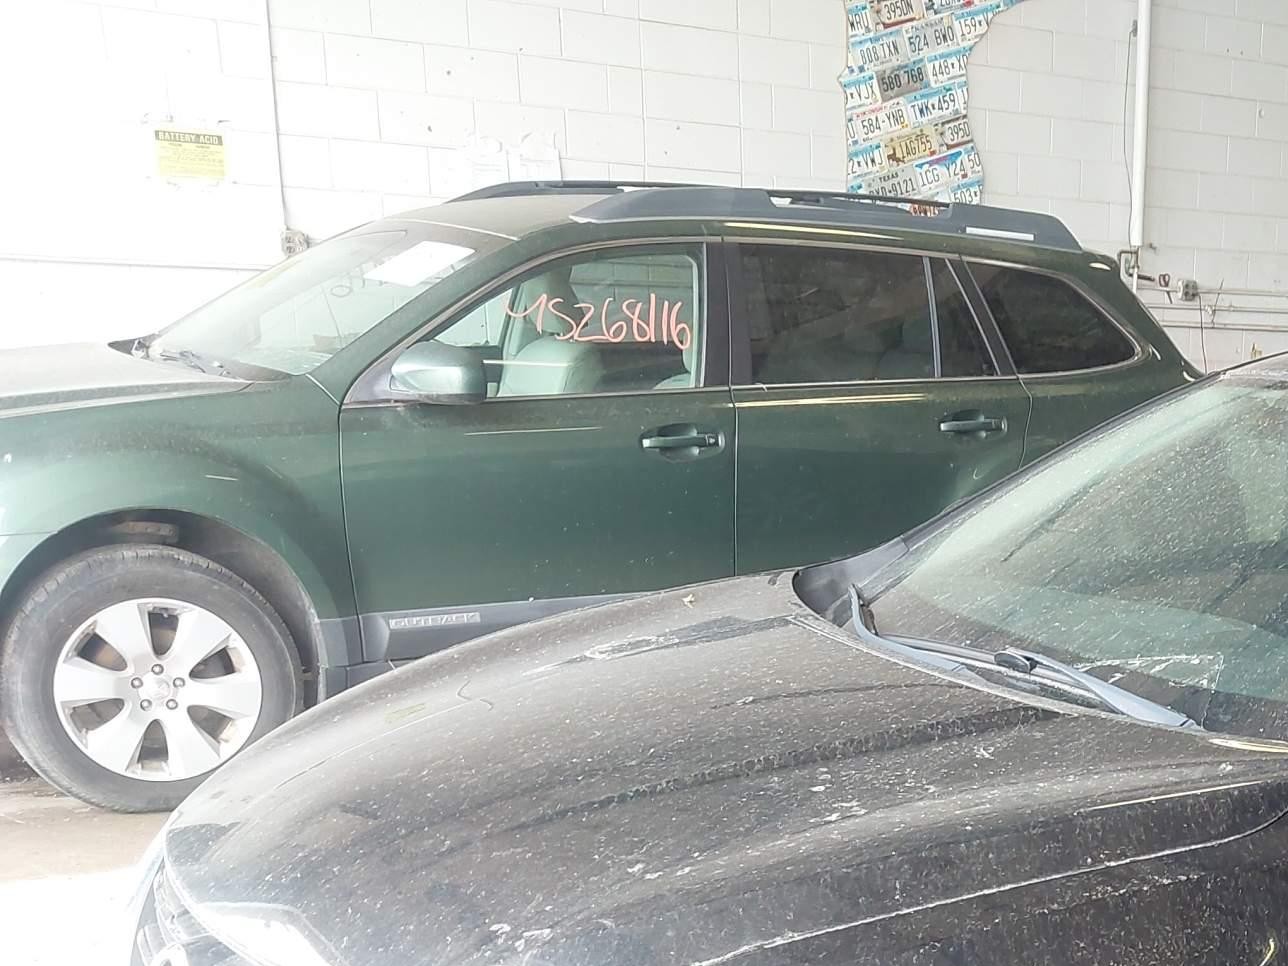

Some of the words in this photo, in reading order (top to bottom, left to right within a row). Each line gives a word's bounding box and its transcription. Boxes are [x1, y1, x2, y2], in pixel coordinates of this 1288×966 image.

[158, 131, 196, 143] BATTERY
[199, 135, 219, 144] ACID
[879, 171, 899, 183] TEXAS
